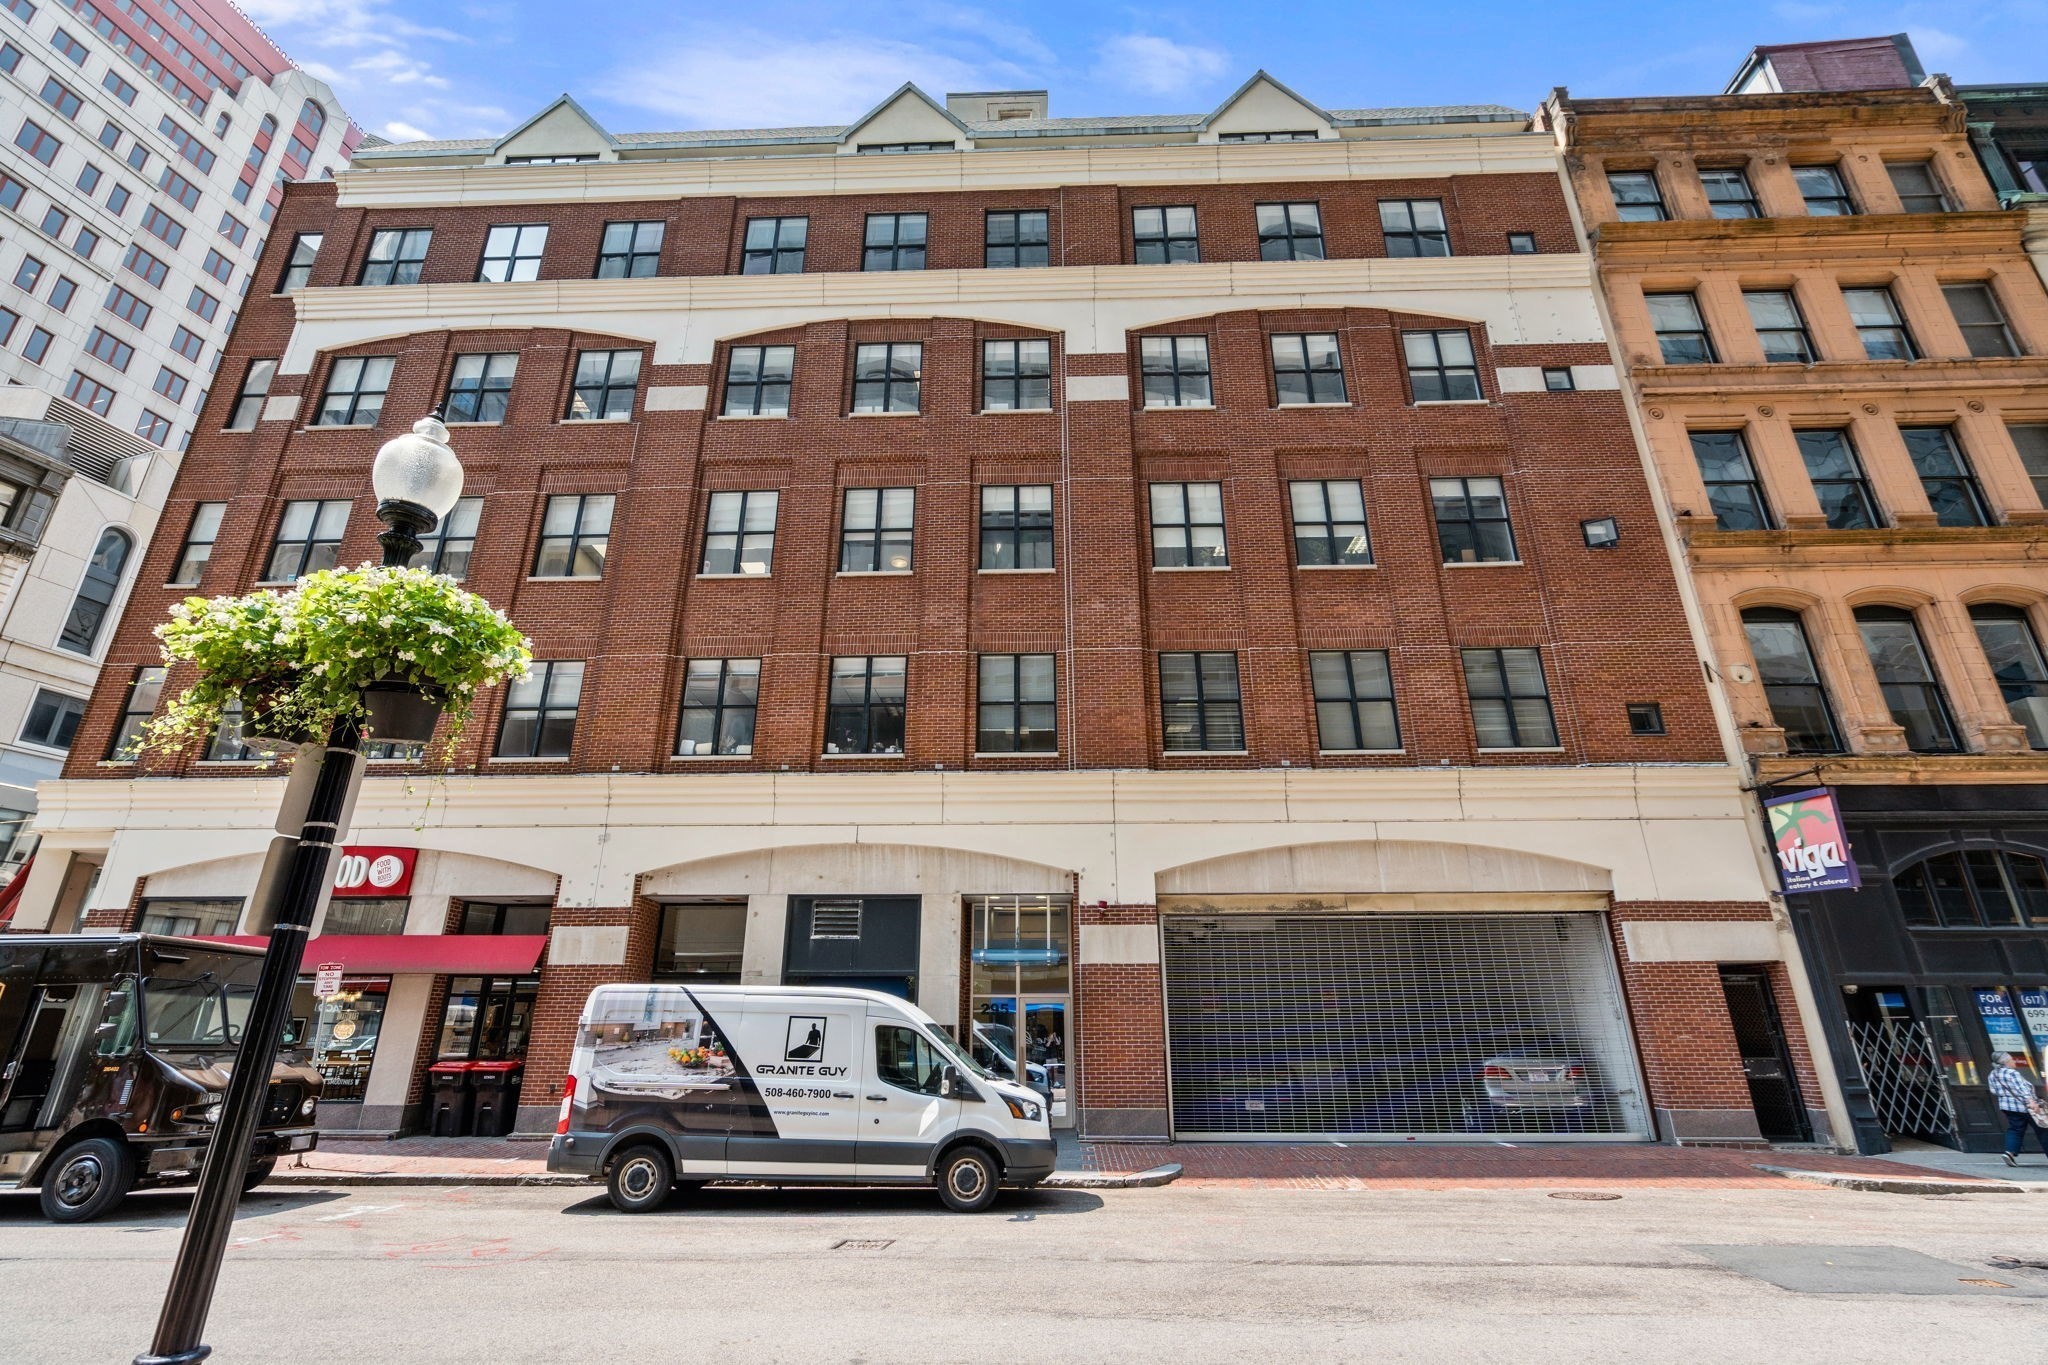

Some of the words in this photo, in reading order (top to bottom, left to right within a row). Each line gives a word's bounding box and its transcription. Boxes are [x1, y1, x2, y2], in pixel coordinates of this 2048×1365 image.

[376, 859, 391, 868] FOOD
[1777, 837, 1846, 879] viga
[376, 866, 392, 875] WITH
[1786, 875, 1811, 883] italian
[1788, 881, 1812, 890] eatery
[1819, 878, 1849, 886] caterer
[1979, 994, 2002, 1003] FOR
[2020, 995, 2047, 1006] (617)
[980, 1003, 1009, 1015] 295
[1979, 1006, 2013, 1015] LEASE
[756, 1064, 815, 1076] GRANITE
[818, 1066, 848, 1076] GUY
[764, 1087, 831, 1099] 508-460-7900
